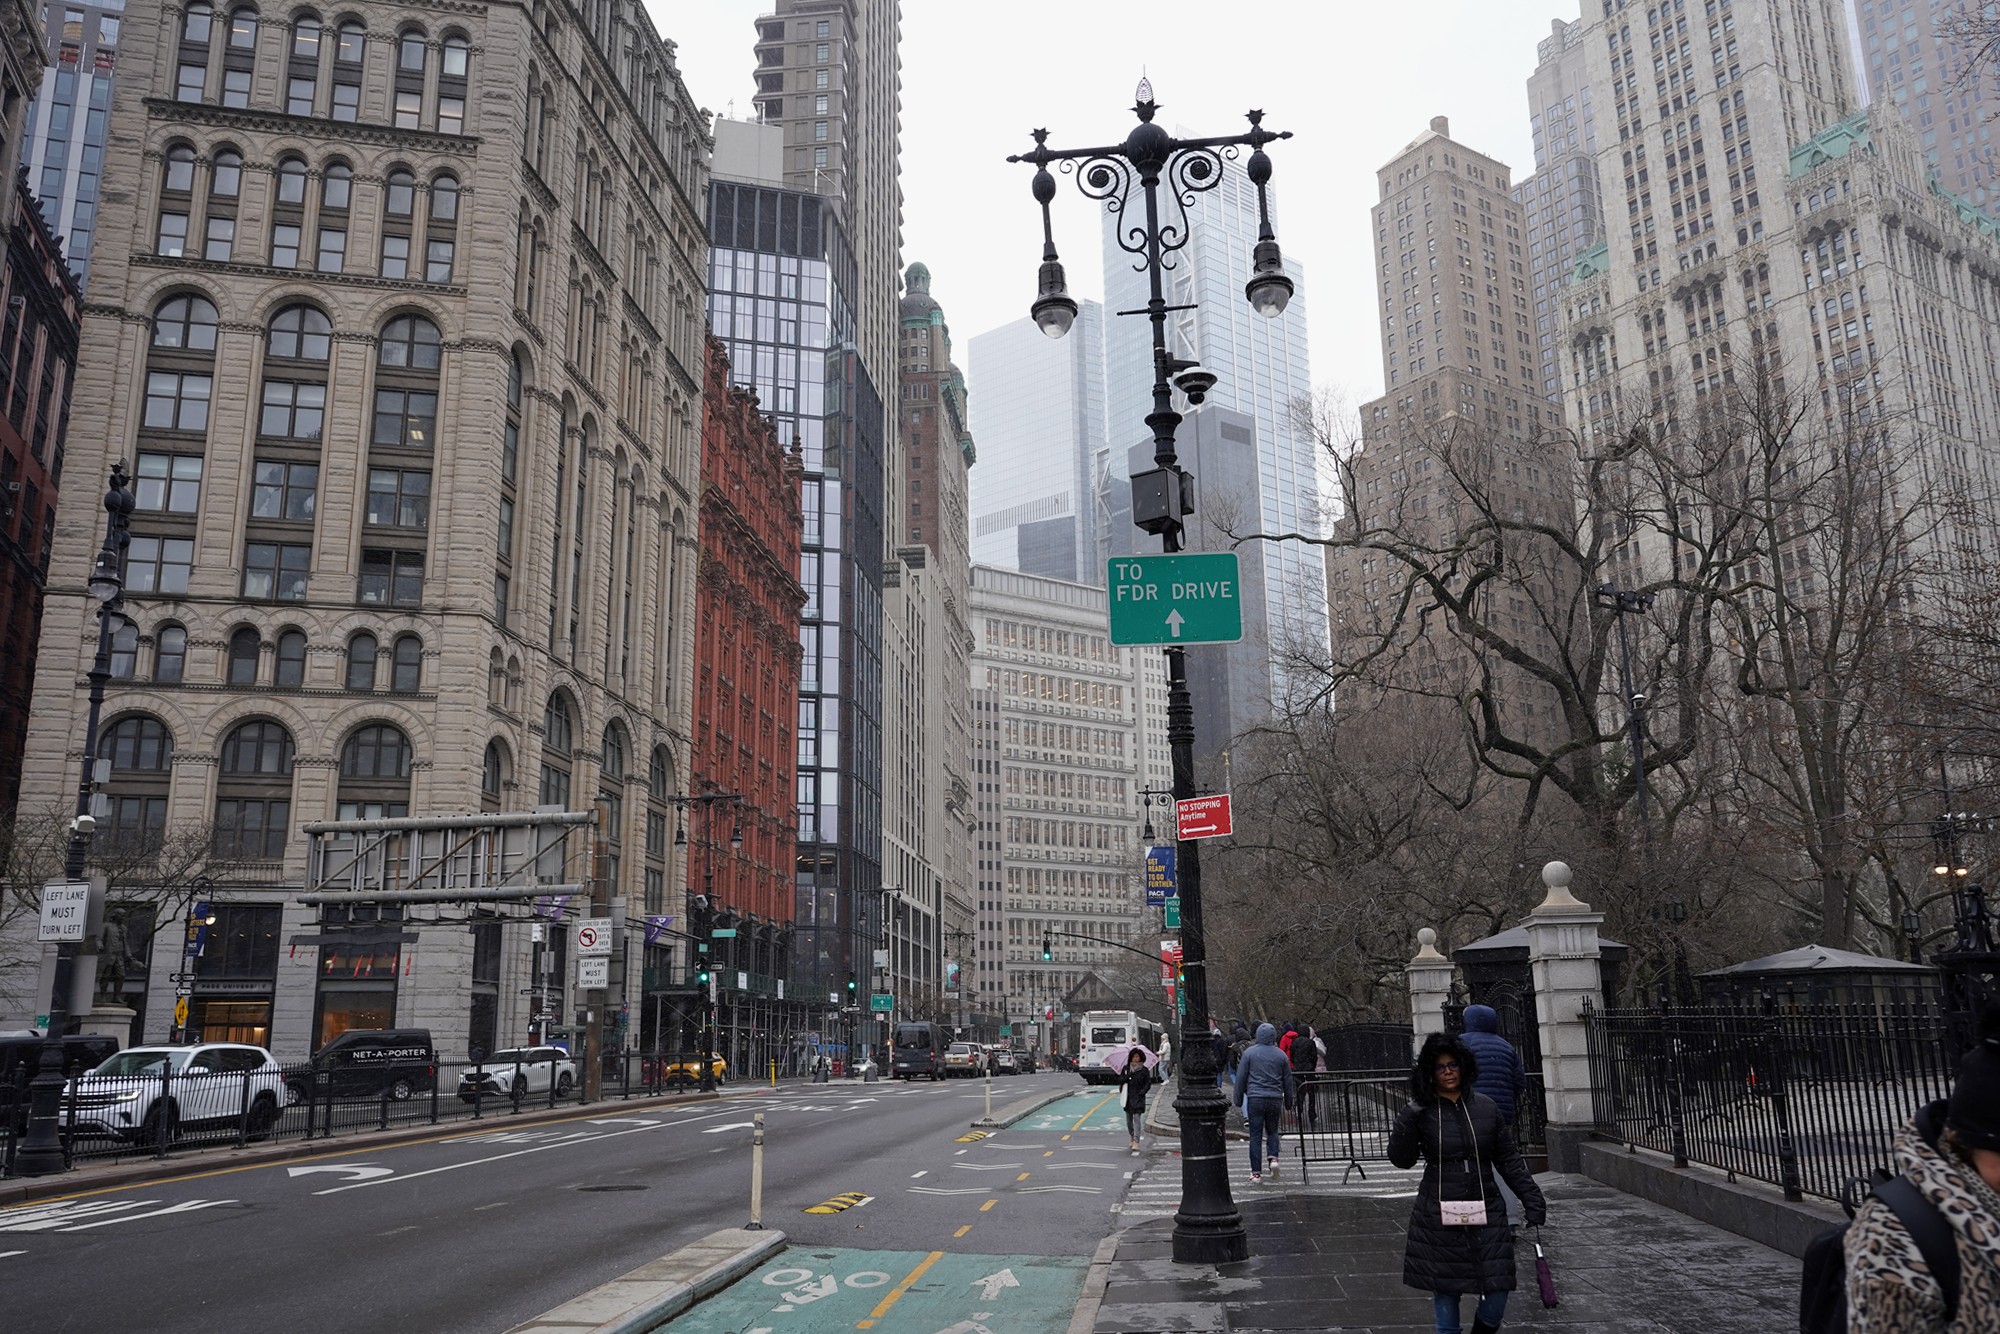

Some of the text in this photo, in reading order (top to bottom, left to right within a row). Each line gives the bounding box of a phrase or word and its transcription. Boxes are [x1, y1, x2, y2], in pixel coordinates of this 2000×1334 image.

[1115, 563, 1143, 581] TO
[1117, 581, 1233, 602] FDR DRIVE
[1179, 800, 1221, 812] NO STOPPING
[1180, 812, 1207, 821] Anytime
[1147, 857, 1158, 865] GET
[46, 890, 85, 901] LEFT LANE
[50, 906, 75, 919] MUST
[42, 924, 81, 935] TURN LEFT
[352, 1048, 427, 1059] NET-A-PORTER
